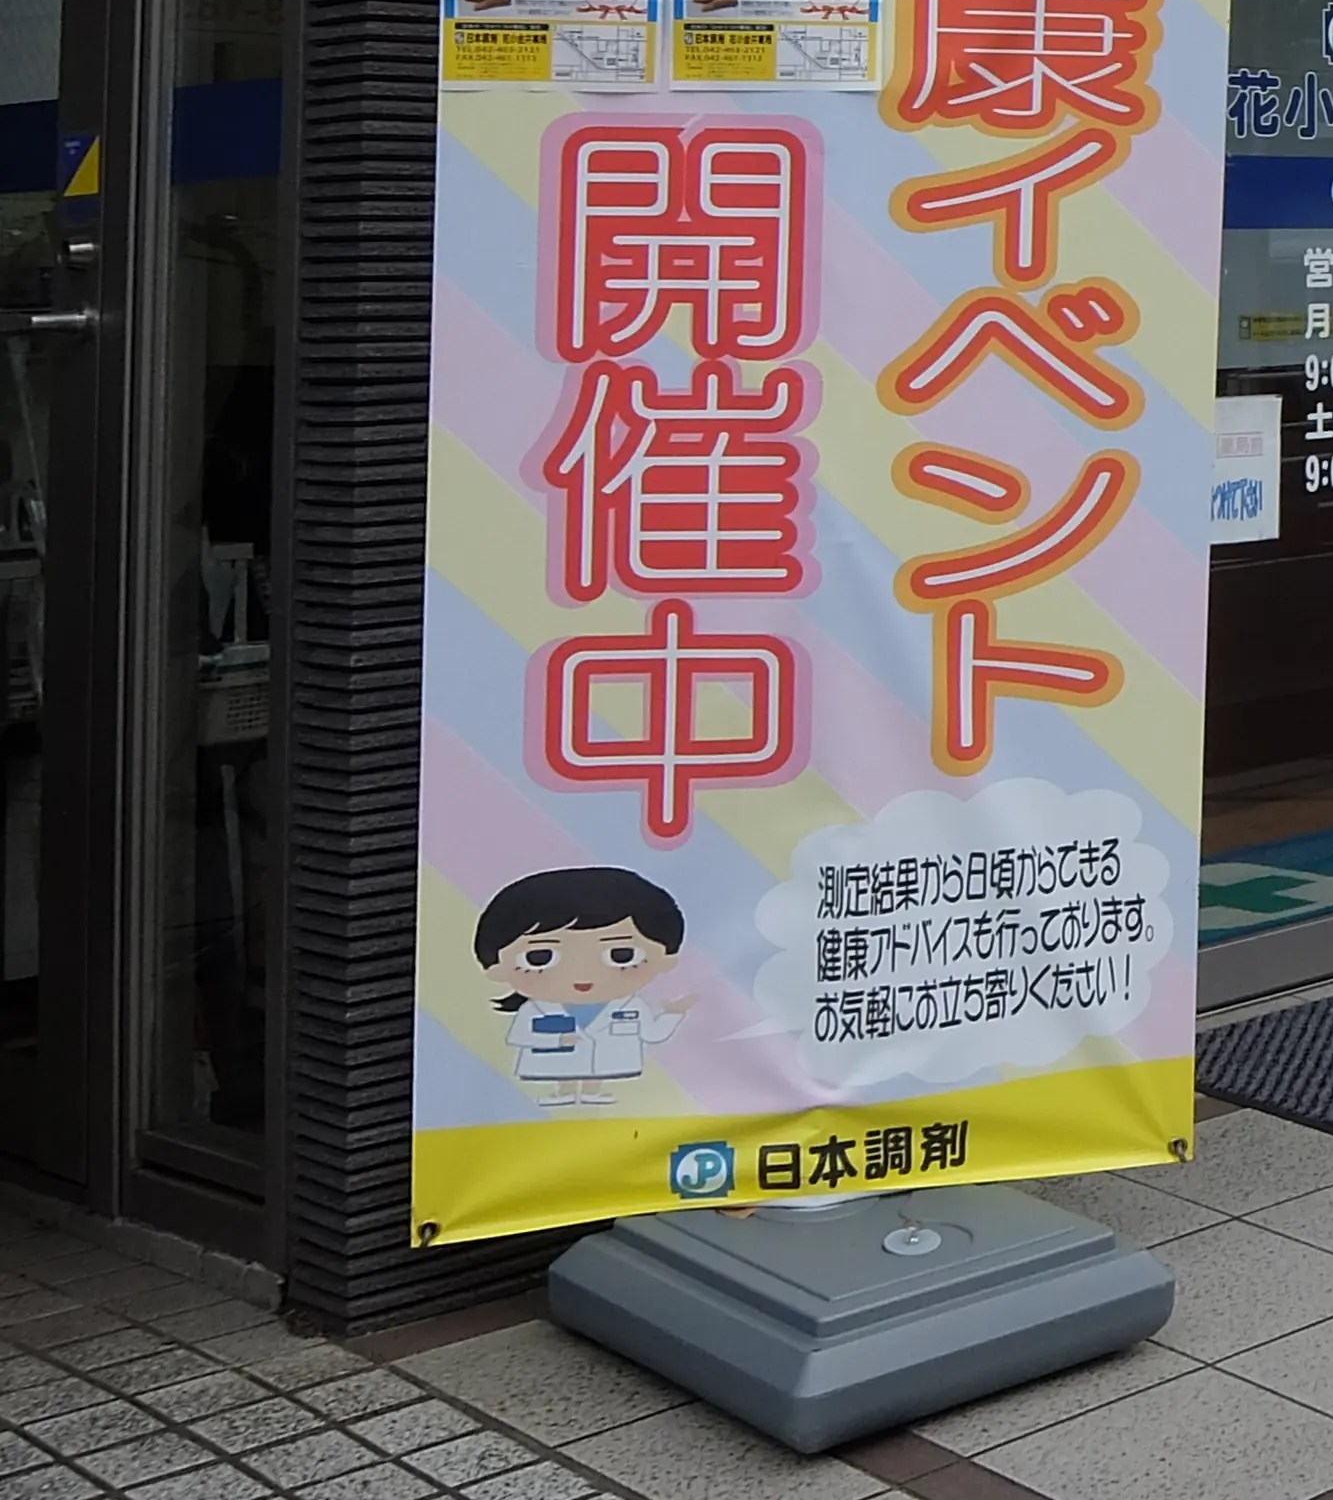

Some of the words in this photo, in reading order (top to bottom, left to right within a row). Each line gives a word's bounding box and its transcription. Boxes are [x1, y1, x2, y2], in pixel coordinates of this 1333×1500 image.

[543, 125, 807, 838] 開催中
[816, 837, 1120, 919] 測定結果から日頃からできる
[816, 893, 1154, 983] 健康アドバイスも行っております。
[757, 1121, 969, 1191] 日本調剤
